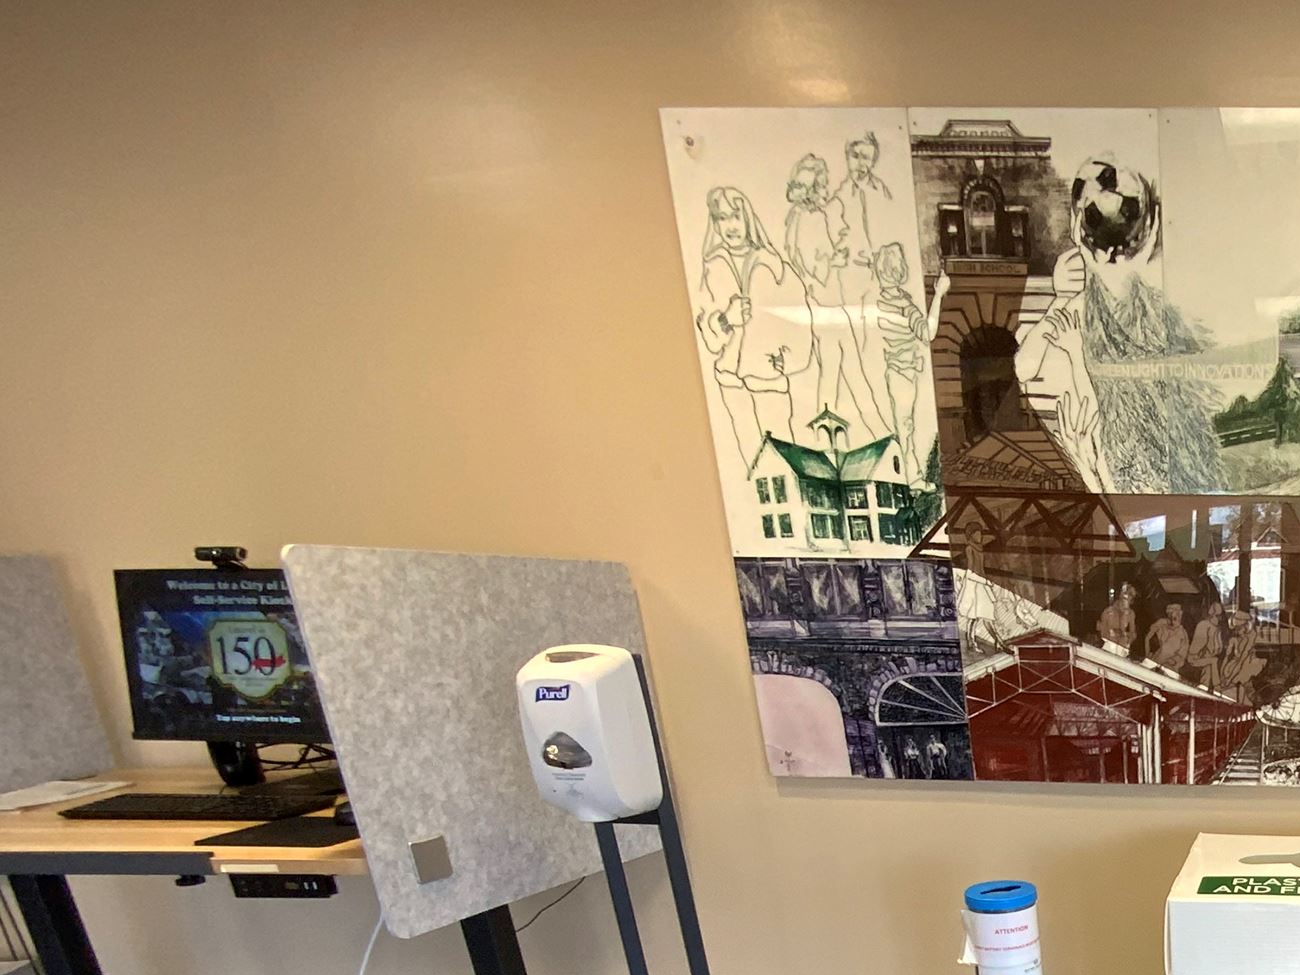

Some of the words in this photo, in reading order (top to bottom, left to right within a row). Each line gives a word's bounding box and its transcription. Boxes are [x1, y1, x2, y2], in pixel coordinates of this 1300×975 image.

[215, 636, 276, 676] 150
[1212, 885, 1272, 894] AND
[994, 925, 1029, 935] ATTENTION
